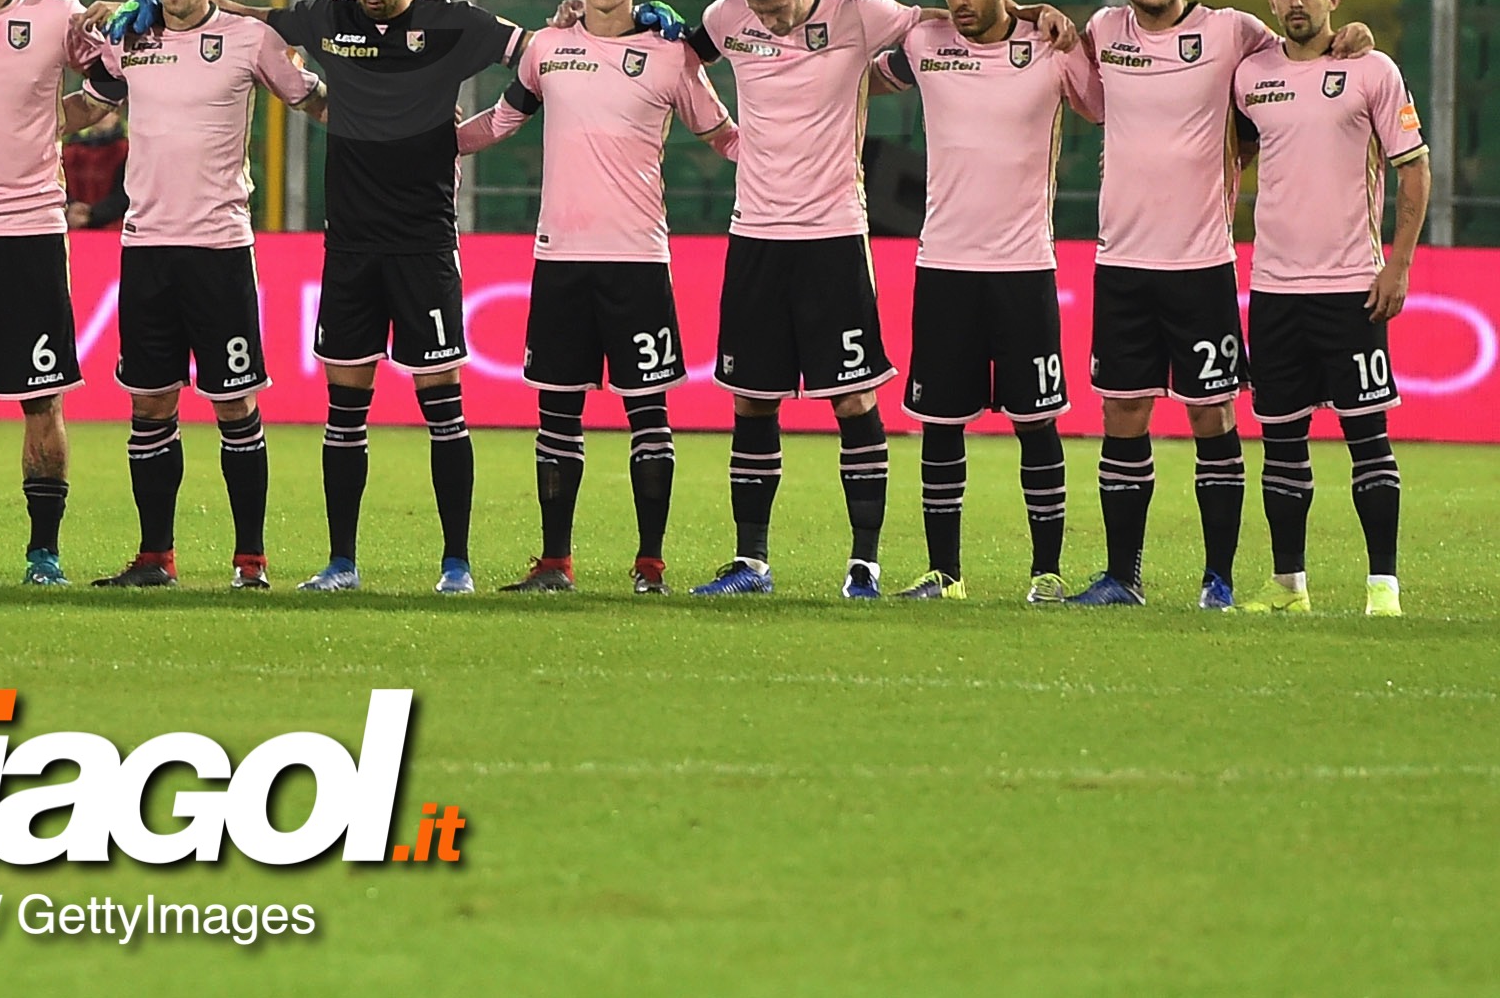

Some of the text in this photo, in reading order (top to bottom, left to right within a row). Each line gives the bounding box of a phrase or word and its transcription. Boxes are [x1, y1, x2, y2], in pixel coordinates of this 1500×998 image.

[321, 38, 379, 58] Bisaten
[554, 47, 586, 57] LEGEA
[936, 48, 969, 57] LEGEA
[120, 52, 178, 69] Bisaten
[539, 58, 599, 75] Bisaten
[919, 58, 982, 73] Bisaten
[1100, 49, 1153, 68] Bisaten
[428, 308, 447, 346] 1
[31, 333, 57, 373] 6
[226, 336, 251, 374] 8
[424, 346, 461, 361] LEGEA
[633, 326, 677, 371] 32
[842, 329, 865, 368] 5
[1193, 334, 1238, 380] 29
[27, 372, 64, 386] LEGEA
[1033, 355, 1061, 394] 19
[1352, 349, 1388, 390] 10
